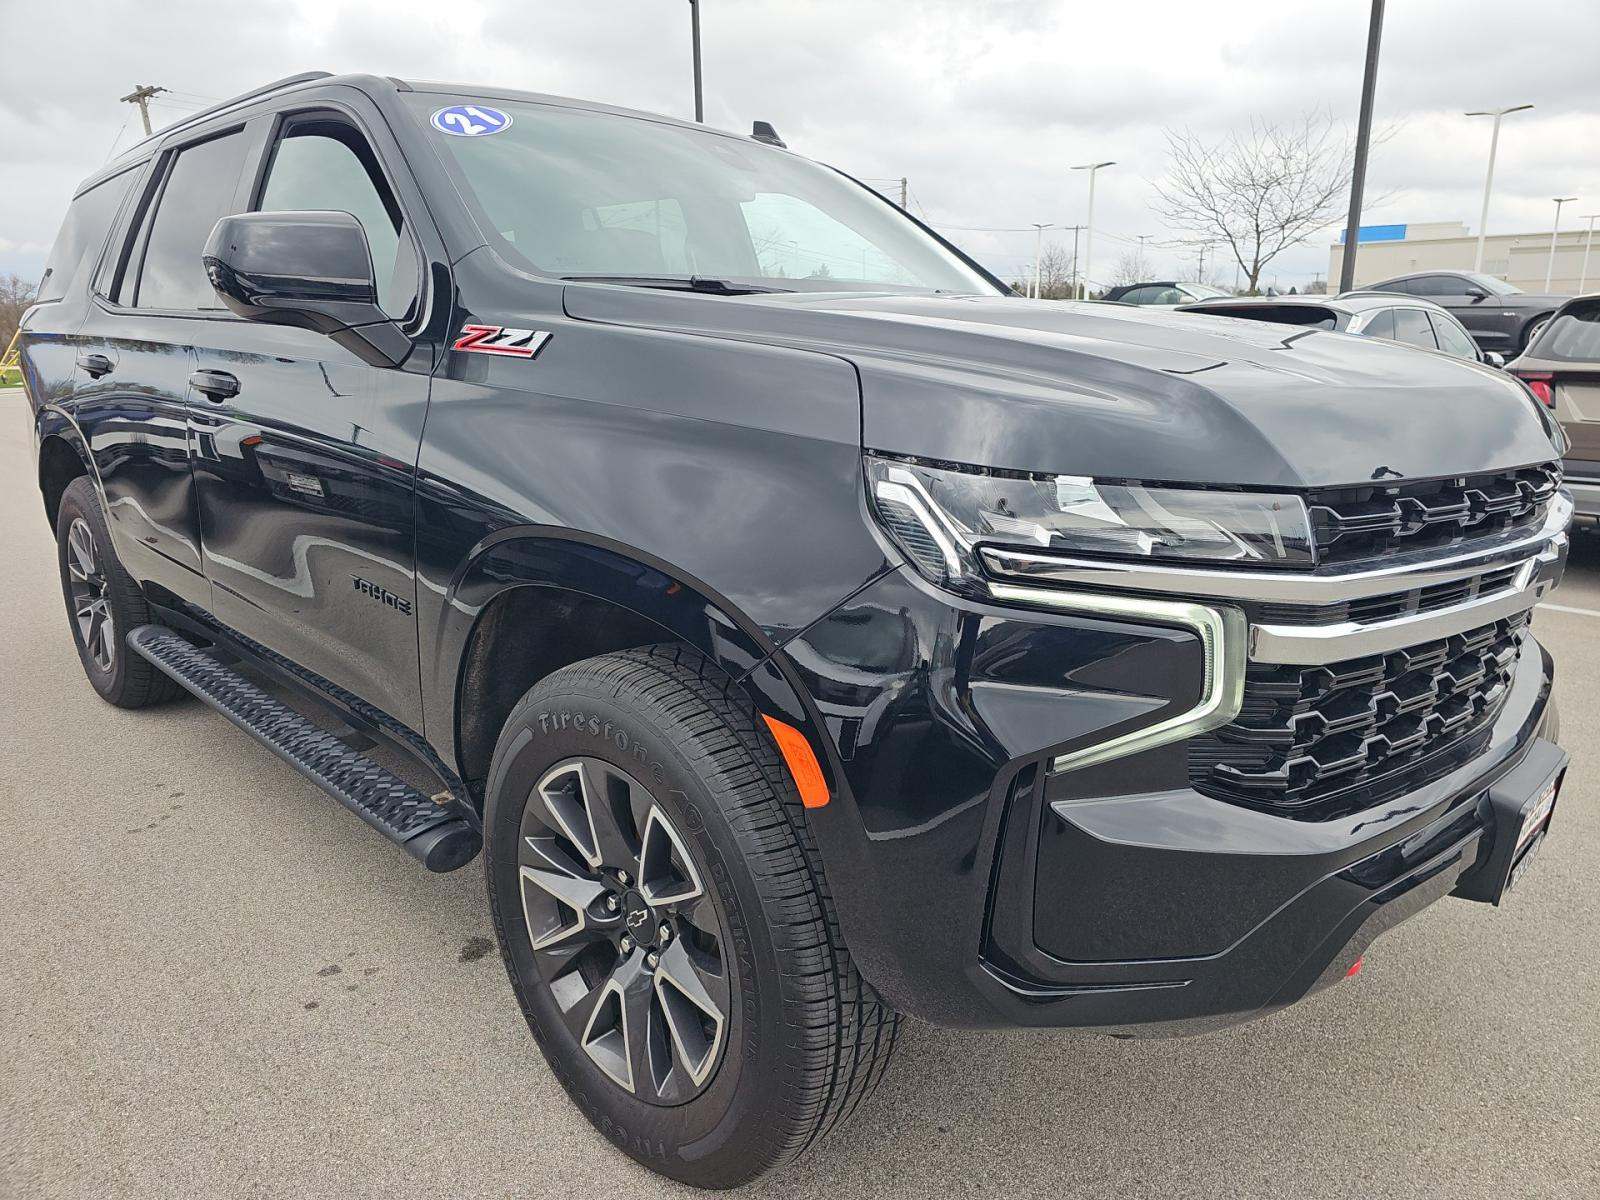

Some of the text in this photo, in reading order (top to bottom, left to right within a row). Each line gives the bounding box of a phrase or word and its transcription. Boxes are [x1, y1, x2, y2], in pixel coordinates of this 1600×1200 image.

[444, 107, 502, 135] 21
[451, 324, 552, 359] Z71
[349, 574, 412, 616] TAHOE
[536, 708, 666, 785] Firestone
